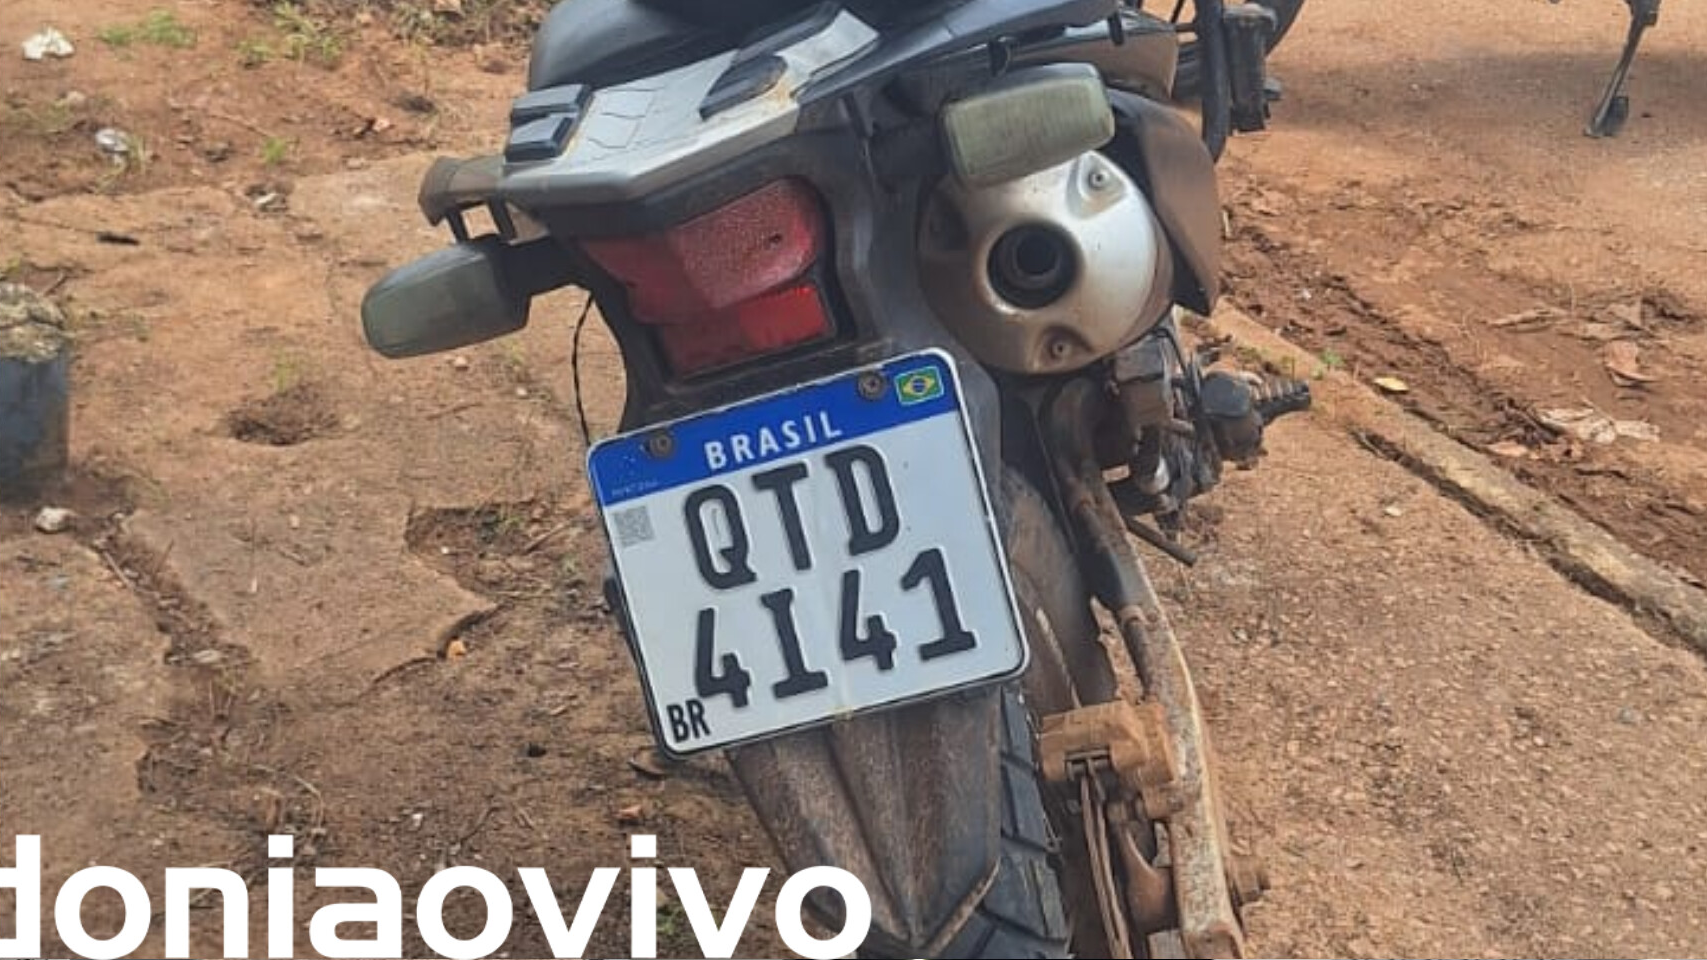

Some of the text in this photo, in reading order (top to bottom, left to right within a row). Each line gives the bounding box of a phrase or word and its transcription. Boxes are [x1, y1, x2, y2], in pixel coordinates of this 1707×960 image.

[704, 411, 842, 470] BRASIL
[684, 444, 900, 590] QTD
[695, 547, 977, 708] 4I41
[666, 699, 711, 744] BR
